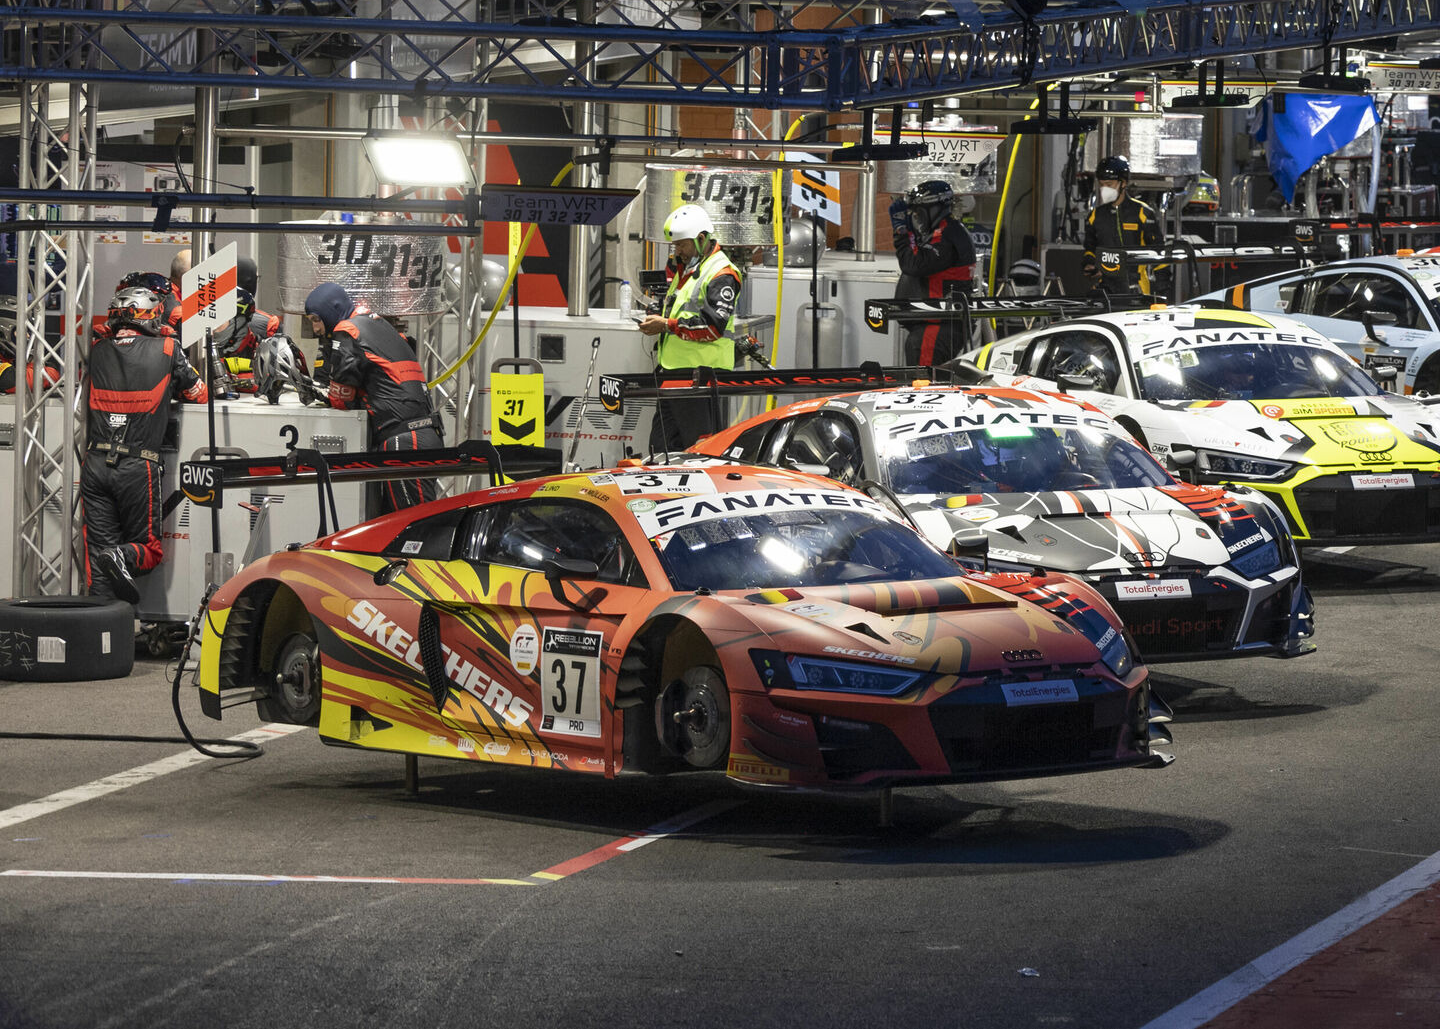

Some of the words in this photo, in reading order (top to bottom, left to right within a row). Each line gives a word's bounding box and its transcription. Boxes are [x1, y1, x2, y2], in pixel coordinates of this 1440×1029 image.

[1382, 68, 1417, 79] Team
[1388, 79, 1402, 87] 30
[1404, 79, 1415, 88] 31
[1416, 80, 1431, 89] 32
[940, 139, 981, 152] WRT
[950, 152, 965, 162] 37
[681, 173, 729, 202] 30
[725, 185, 761, 214] 31
[503, 194, 556, 209] Team
[562, 195, 609, 212] WRT
[503, 208, 522, 221] 30
[528, 209, 543, 222] 31
[548, 210, 567, 223] 32
[573, 211, 591, 224] 37
[1295, 224, 1313, 236] aws
[318, 232, 373, 265] 30
[371, 243, 412, 278] 31
[408, 254, 443, 289] 32
[1101, 251, 1120, 264] aws
[197, 274, 206, 317] START
[208, 272, 217, 320] ENGINE
[868, 305, 883, 319] aws
[1142, 331, 1324, 356] FANATEC
[601, 378, 620, 398] aws
[893, 392, 947, 405] 32
[503, 399, 525, 417] 31
[1293, 407, 1313, 415] SIM
[1314, 406, 1354, 415] SPORTS
[110, 415, 127, 423] OMP
[889, 412, 1110, 438] FANATEC
[279, 424, 299, 452] 3
[1152, 444, 1169, 454] OMP
[183, 464, 214, 488] aws
[637, 473, 690, 488] 37
[1358, 475, 1409, 486] TotalEnergies
[545, 485, 560, 493] LIND
[586, 488, 610, 503] MÜLLER
[655, 492, 884, 528] FANATEC
[1226, 532, 1264, 556] SKECHERS
[1123, 583, 1186, 595] TotalEnergies
[1166, 617, 1224, 638] Sport
[554, 633, 597, 647] REBELLION
[1095, 626, 1117, 651] SKECHERS
[822, 645, 918, 665] SKECHERS
[346, 599, 535, 728] SKECHERS
[551, 658, 587, 715] 37
[1010, 685, 1071, 699] TotalEnergies
[569, 719, 584, 732] PRO
[521, 747, 541, 757] CASA
